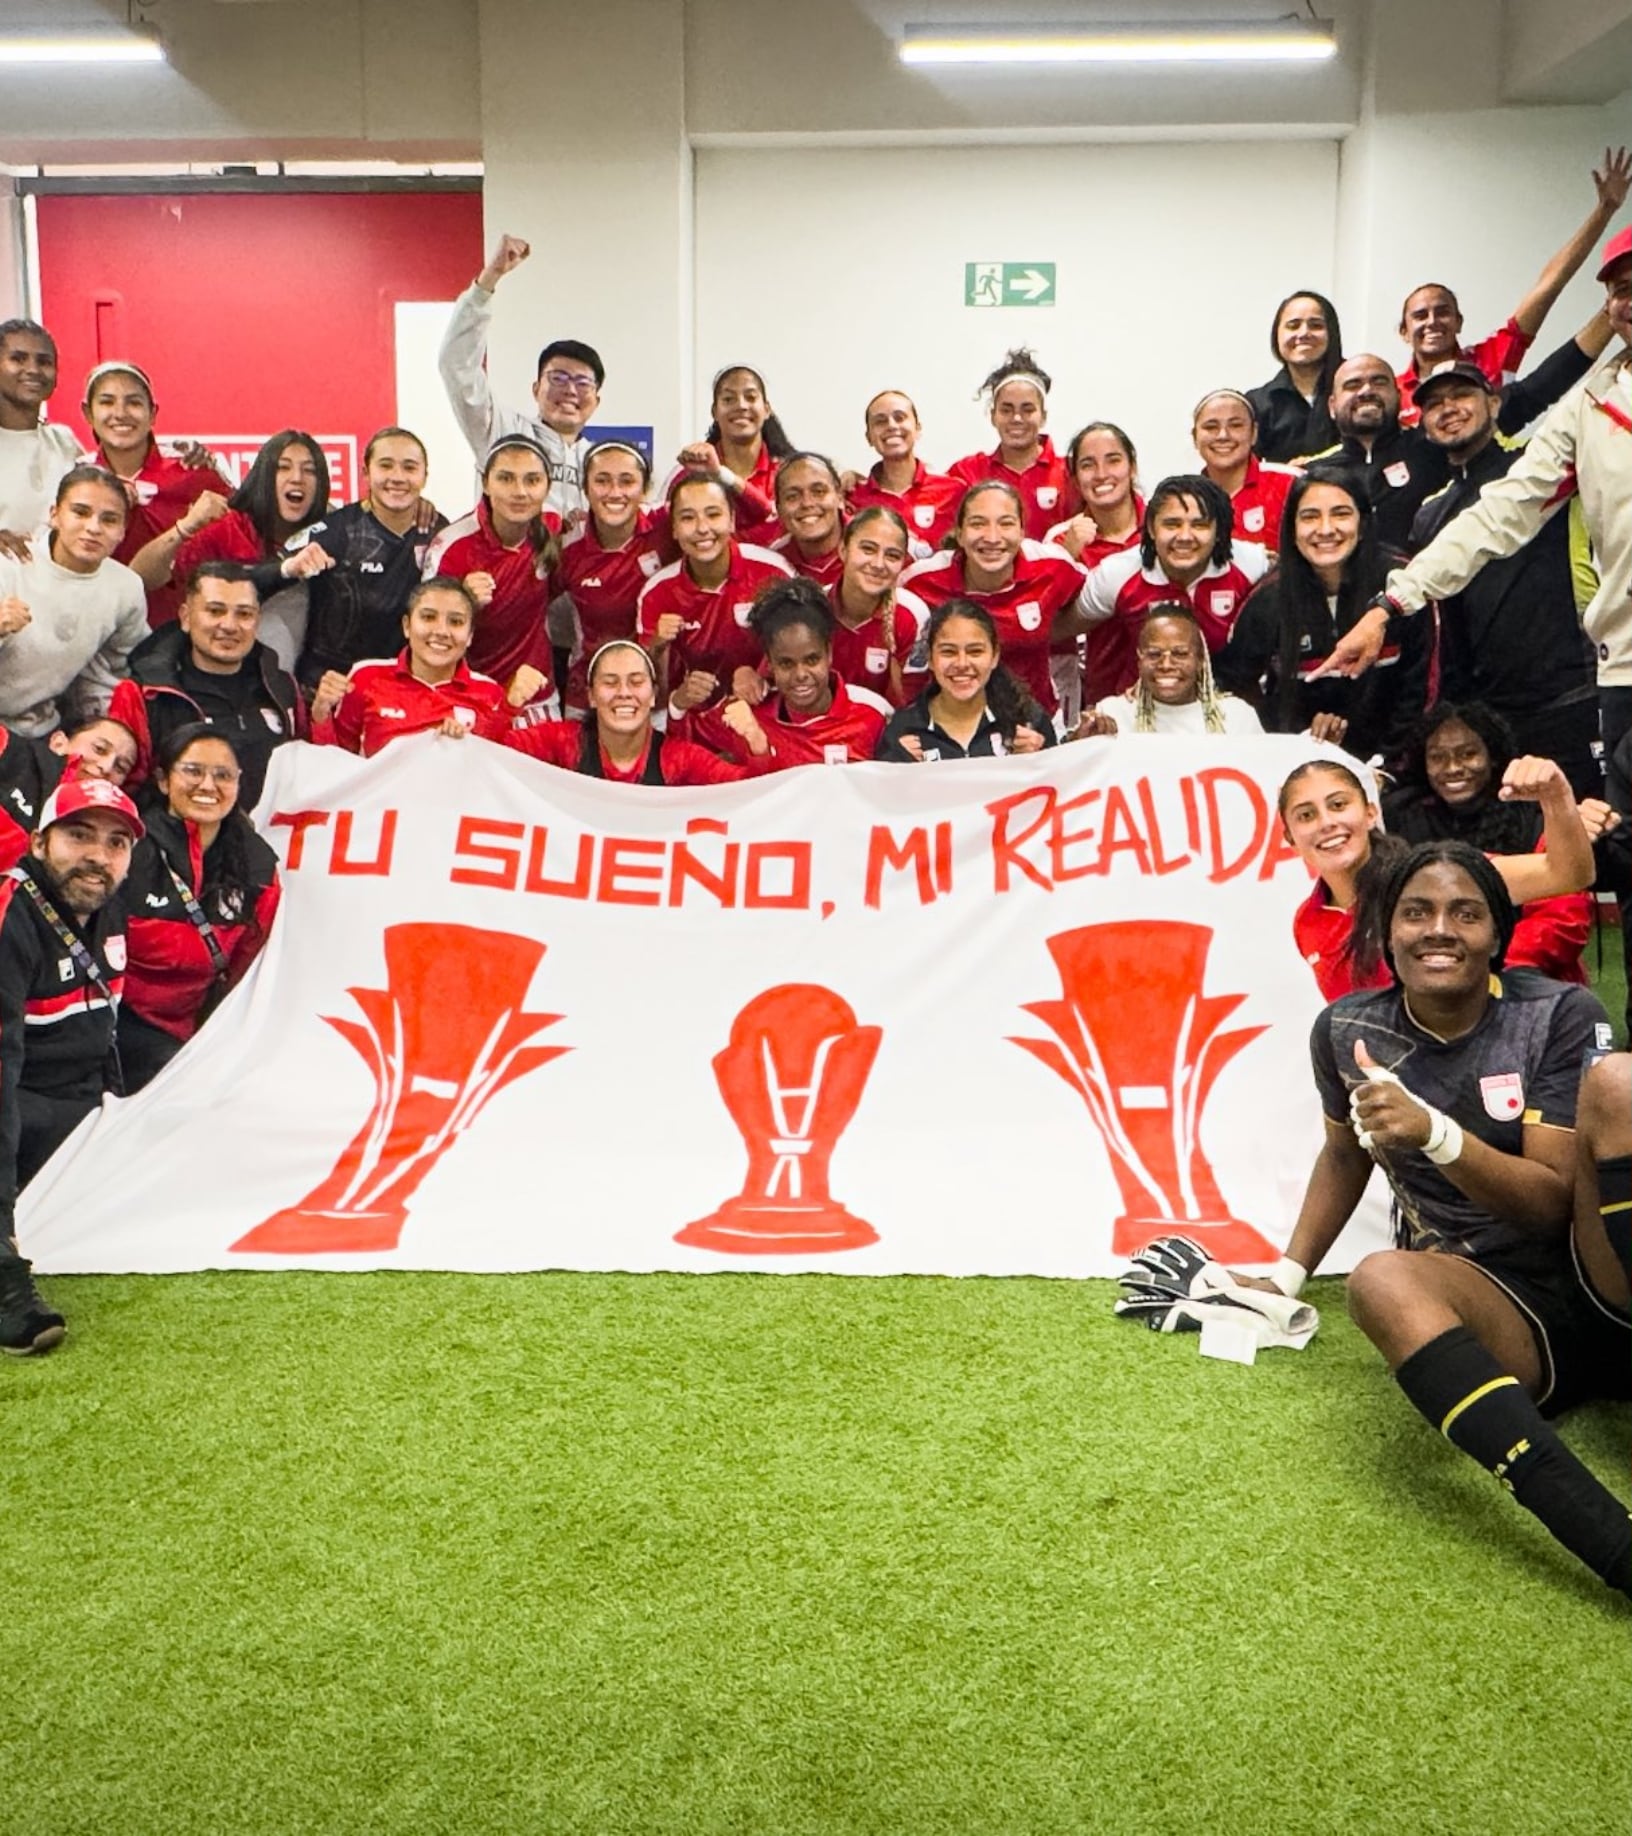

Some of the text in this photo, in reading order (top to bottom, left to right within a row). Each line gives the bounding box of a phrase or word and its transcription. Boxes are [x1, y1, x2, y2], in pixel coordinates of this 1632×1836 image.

[360, 562, 384, 573] FILA
[269, 809, 398, 876] TU
[450, 818, 835, 920] SUEÑO,
[864, 821, 952, 910] MI
